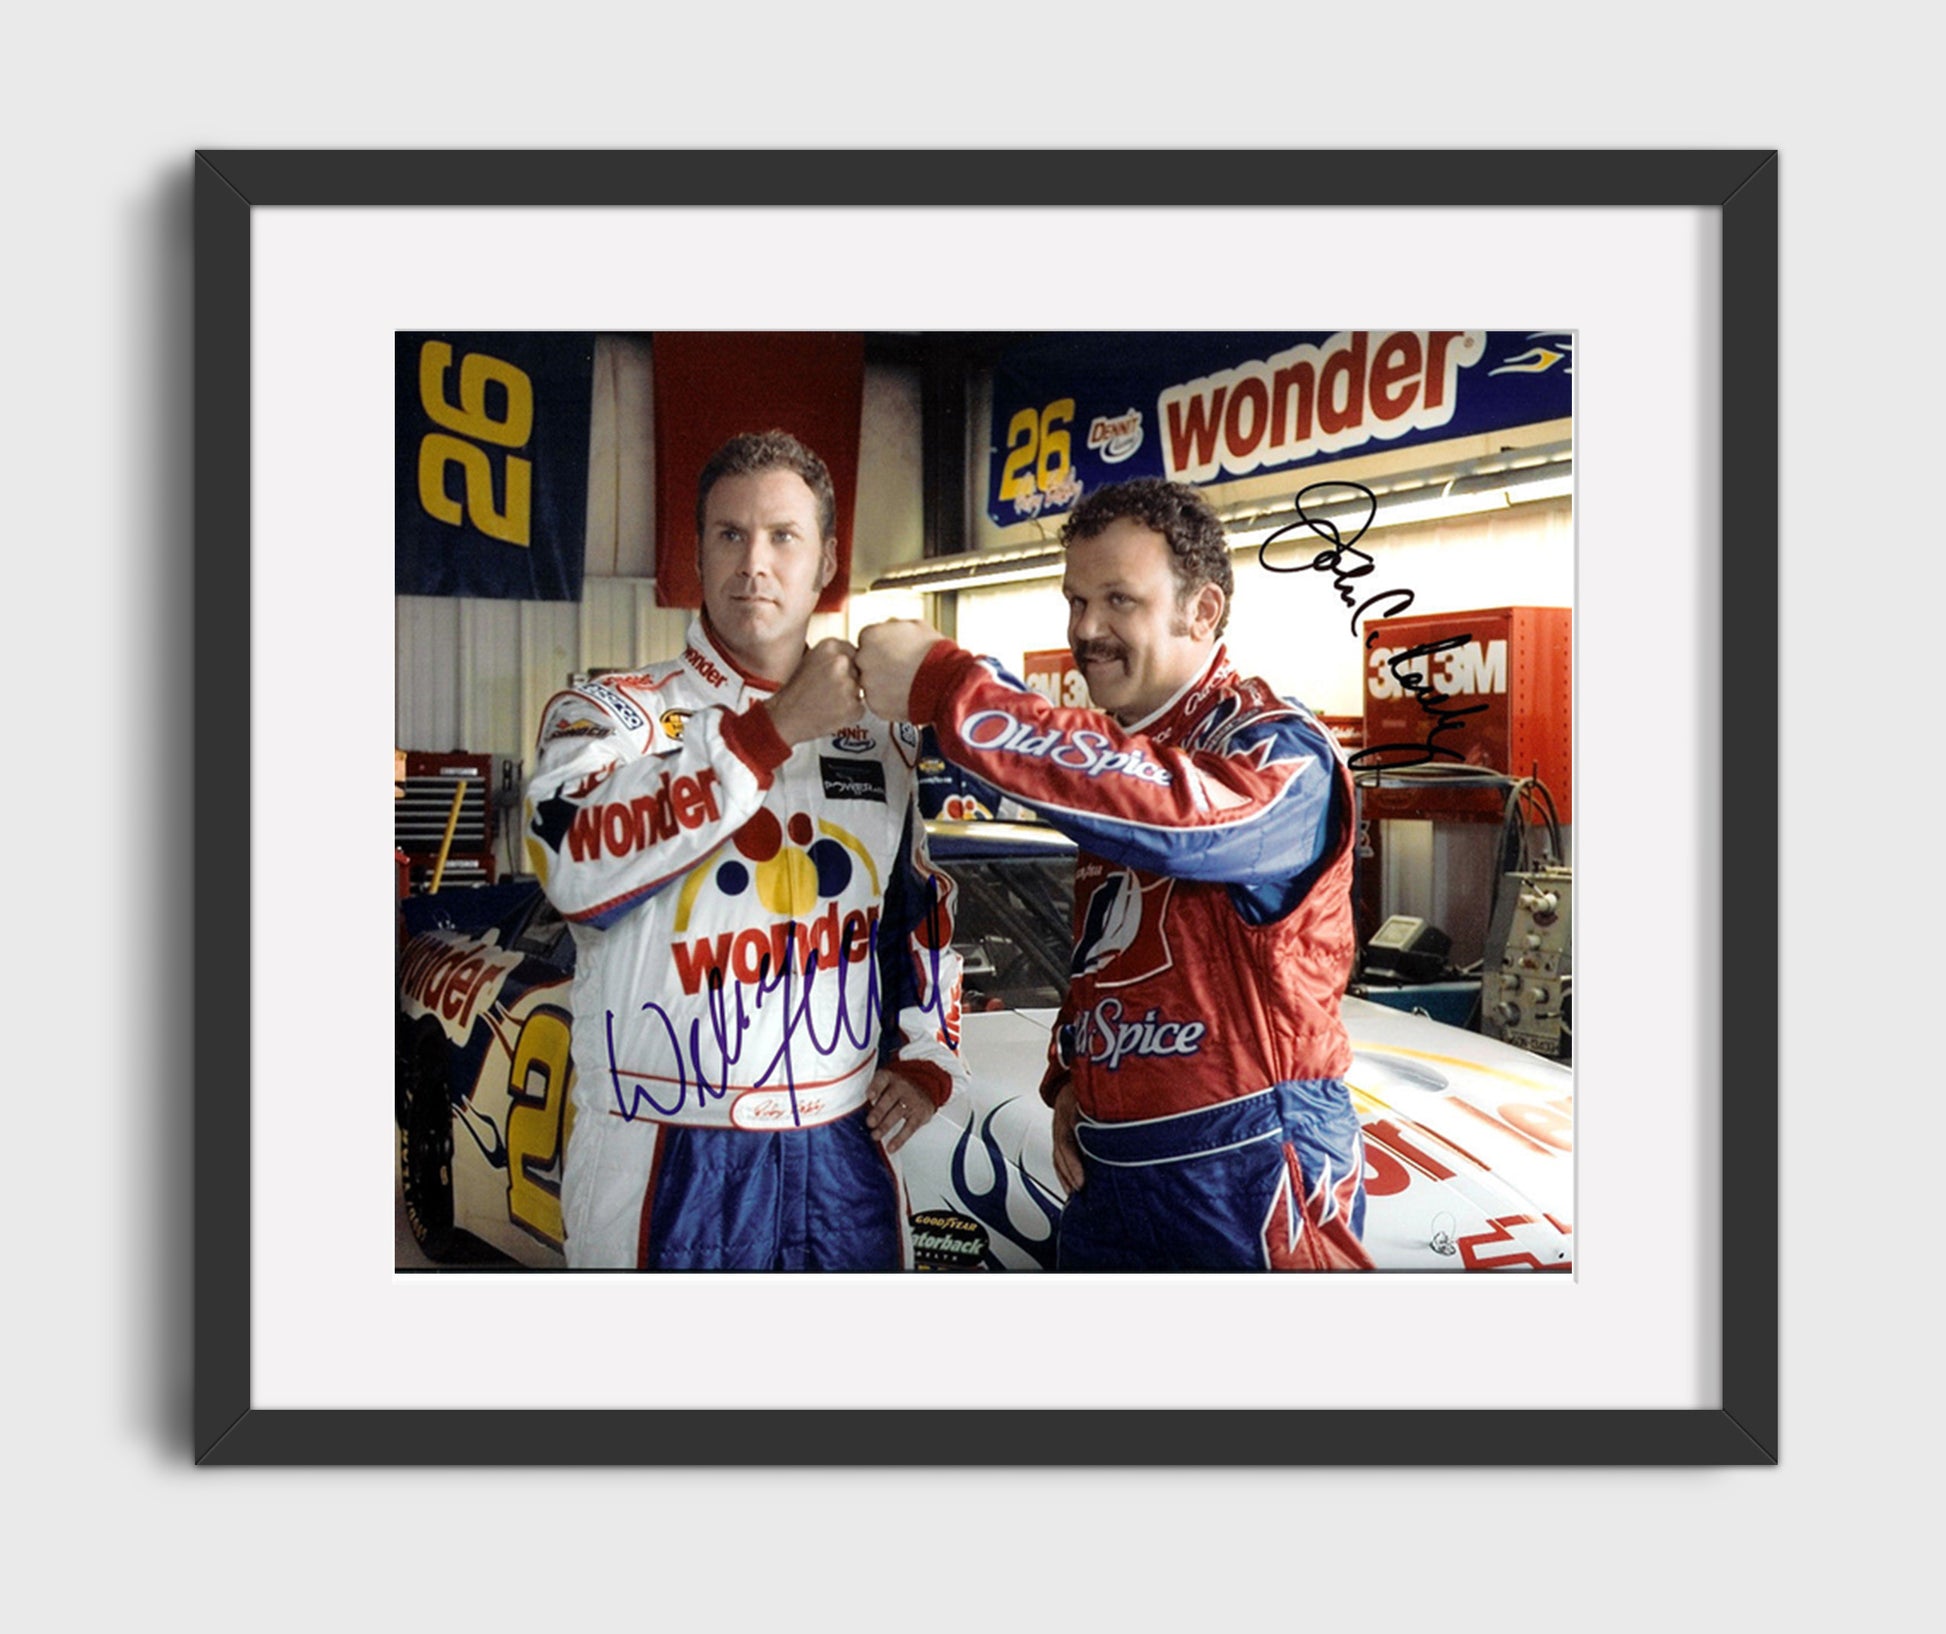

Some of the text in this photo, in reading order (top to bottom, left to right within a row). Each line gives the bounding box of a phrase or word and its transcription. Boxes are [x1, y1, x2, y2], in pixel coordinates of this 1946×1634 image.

[418, 340, 534, 548] 26
[999, 398, 1075, 501] 26
[1166, 331, 1464, 473] wonder
[1433, 640, 1507, 695] 3M
[961, 710, 1062, 756] Old
[1050, 730, 1172, 786] Spice
[568, 767, 721, 863] wonder
[671, 901, 880, 996] wonder
[1090, 997, 1206, 1070] Spice
[911, 1230, 984, 1256] atorback
